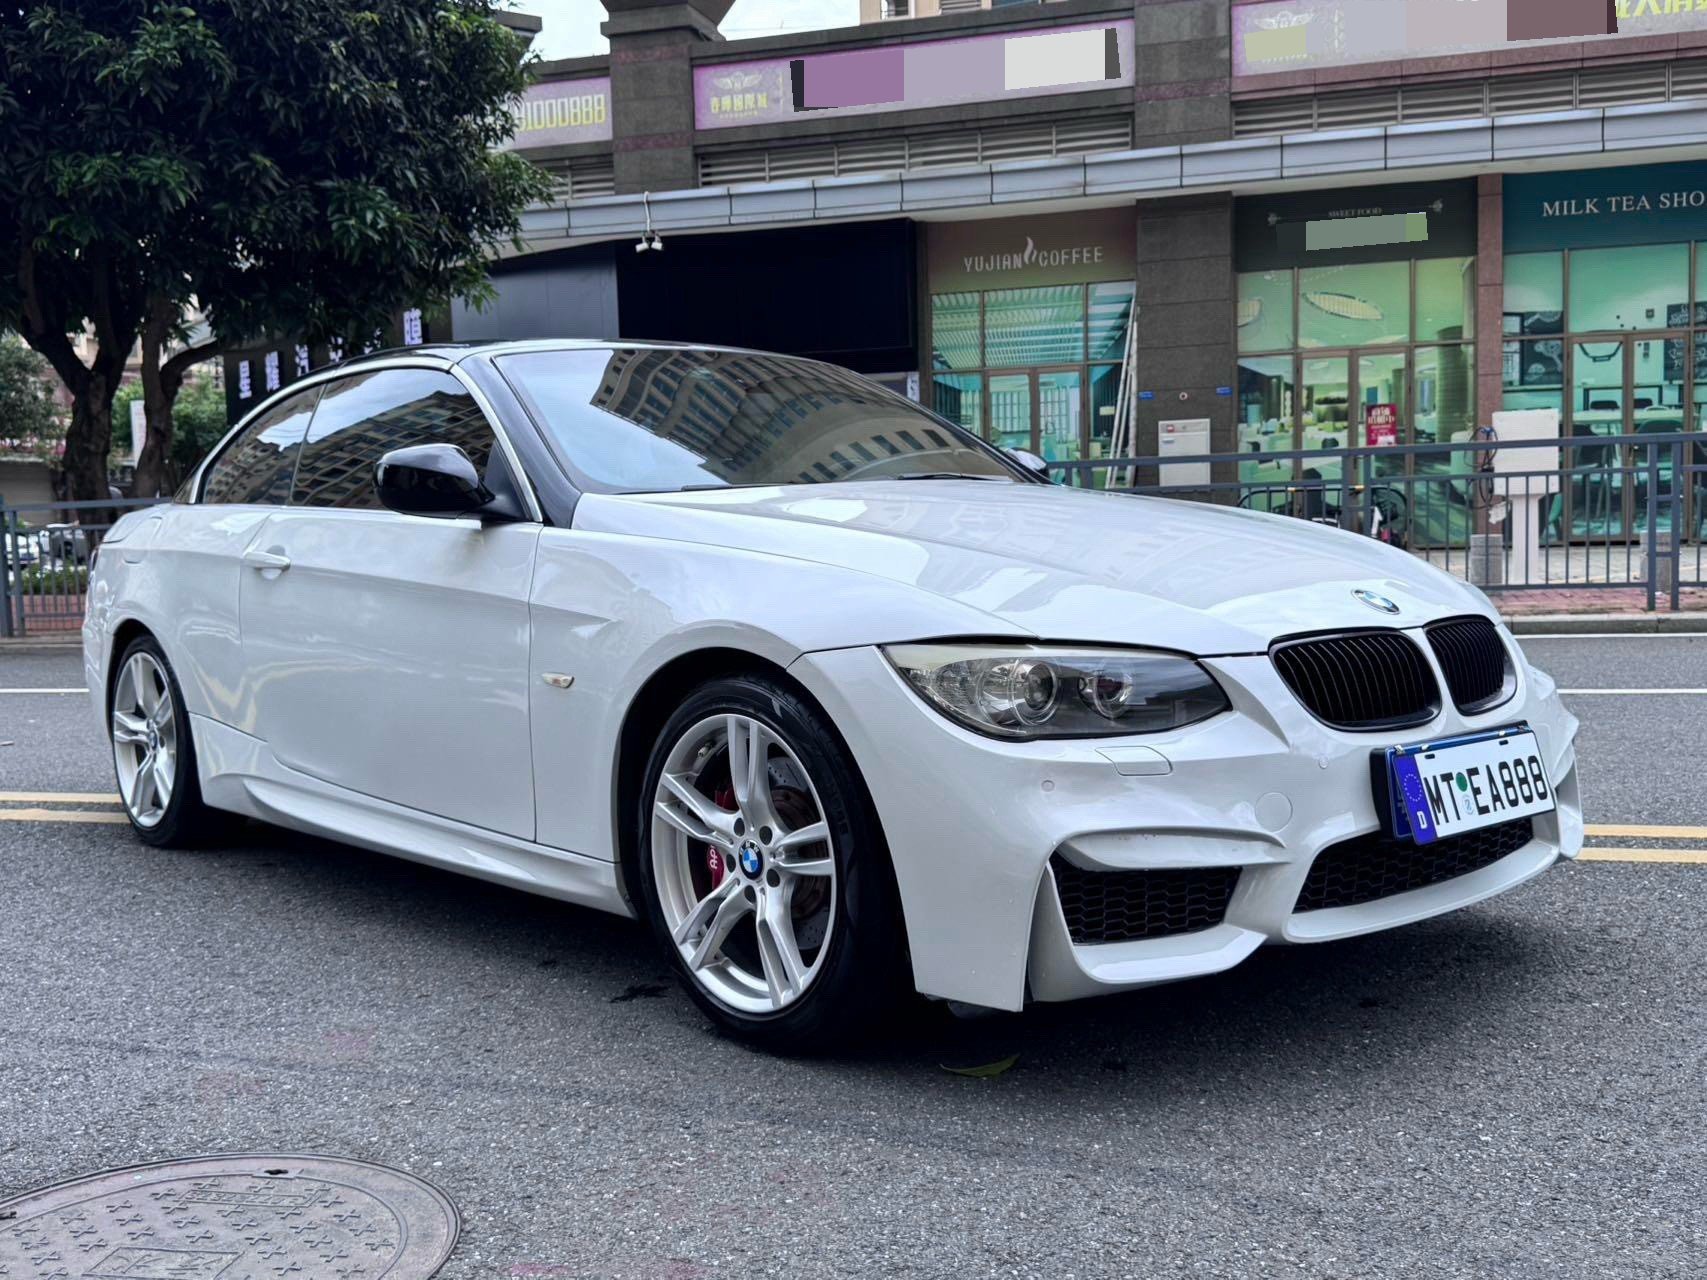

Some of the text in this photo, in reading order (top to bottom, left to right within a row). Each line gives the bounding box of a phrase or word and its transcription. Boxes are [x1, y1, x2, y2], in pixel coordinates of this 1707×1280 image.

[1542, 190, 1705, 217] MILK TEA SHO
[964, 246, 1105, 273] YUJIAN COFFEE
[1423, 755, 1548, 826] MT EA888
[1416, 811, 1427, 829] D
